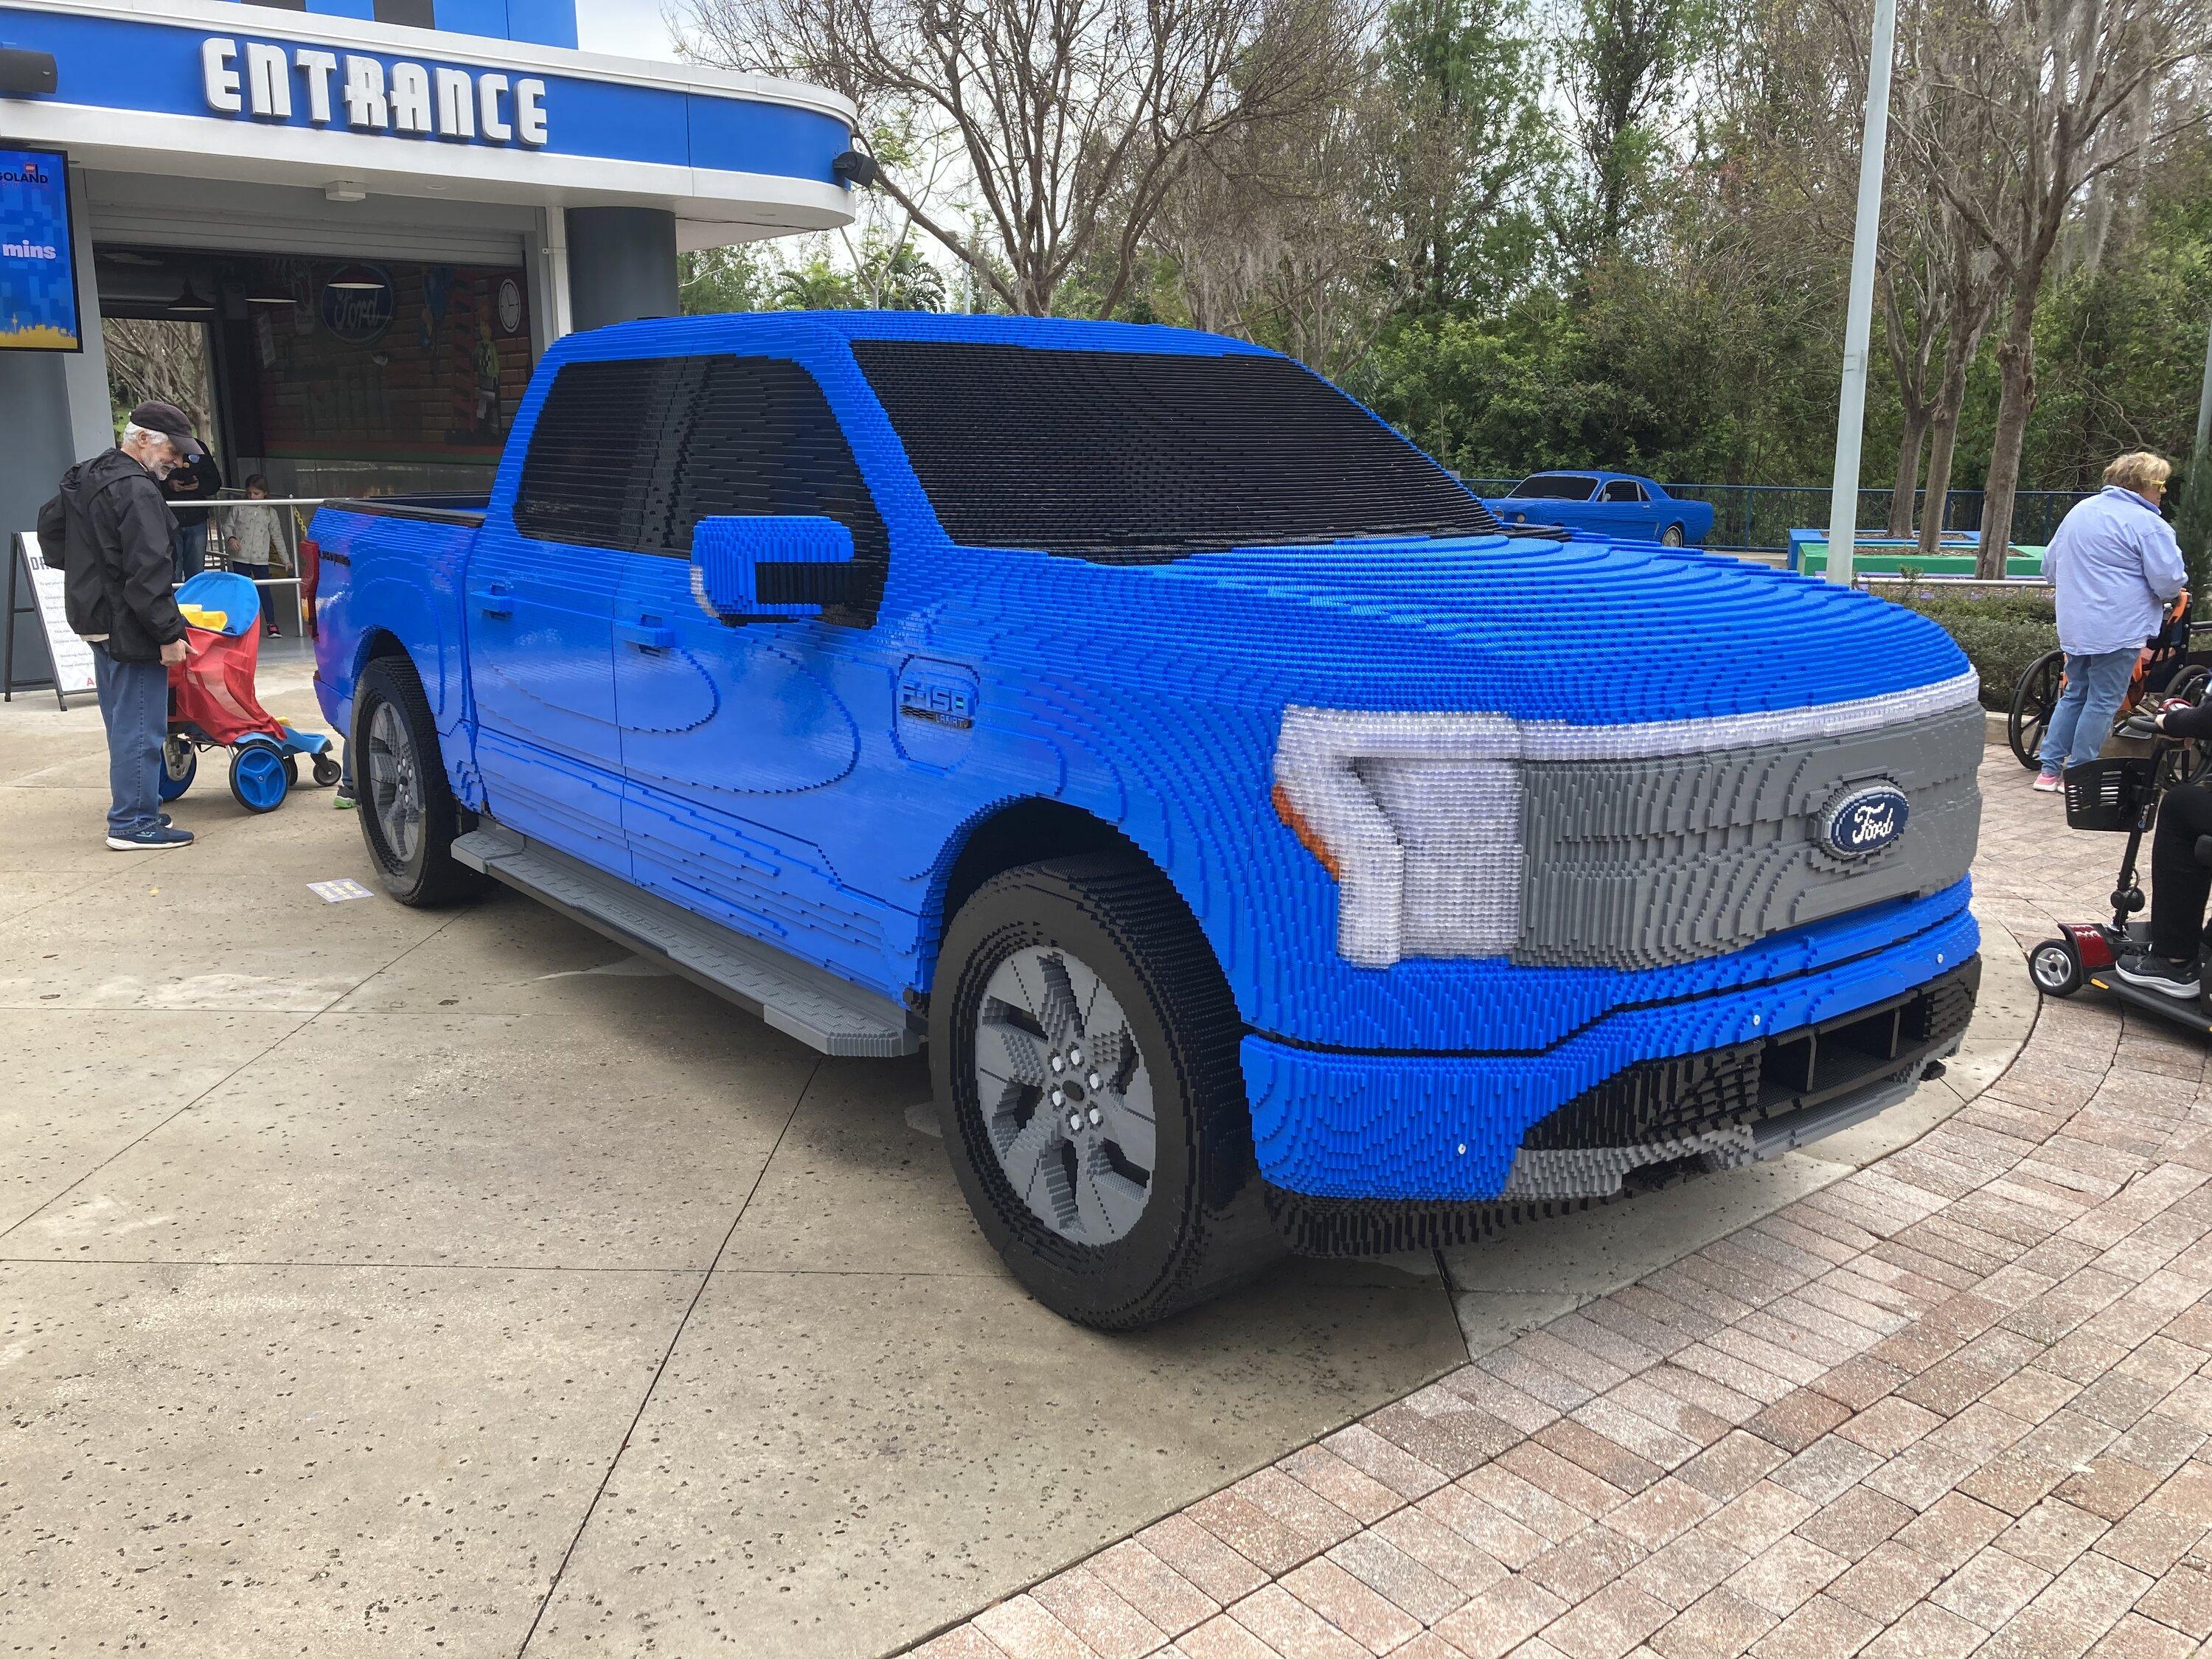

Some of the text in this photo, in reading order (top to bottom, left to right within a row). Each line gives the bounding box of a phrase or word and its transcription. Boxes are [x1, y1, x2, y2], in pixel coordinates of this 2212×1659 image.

[202, 37, 548, 145] ENTRANCE
[2, 239, 56, 260] mins
[1852, 802, 1893, 844] Ford
